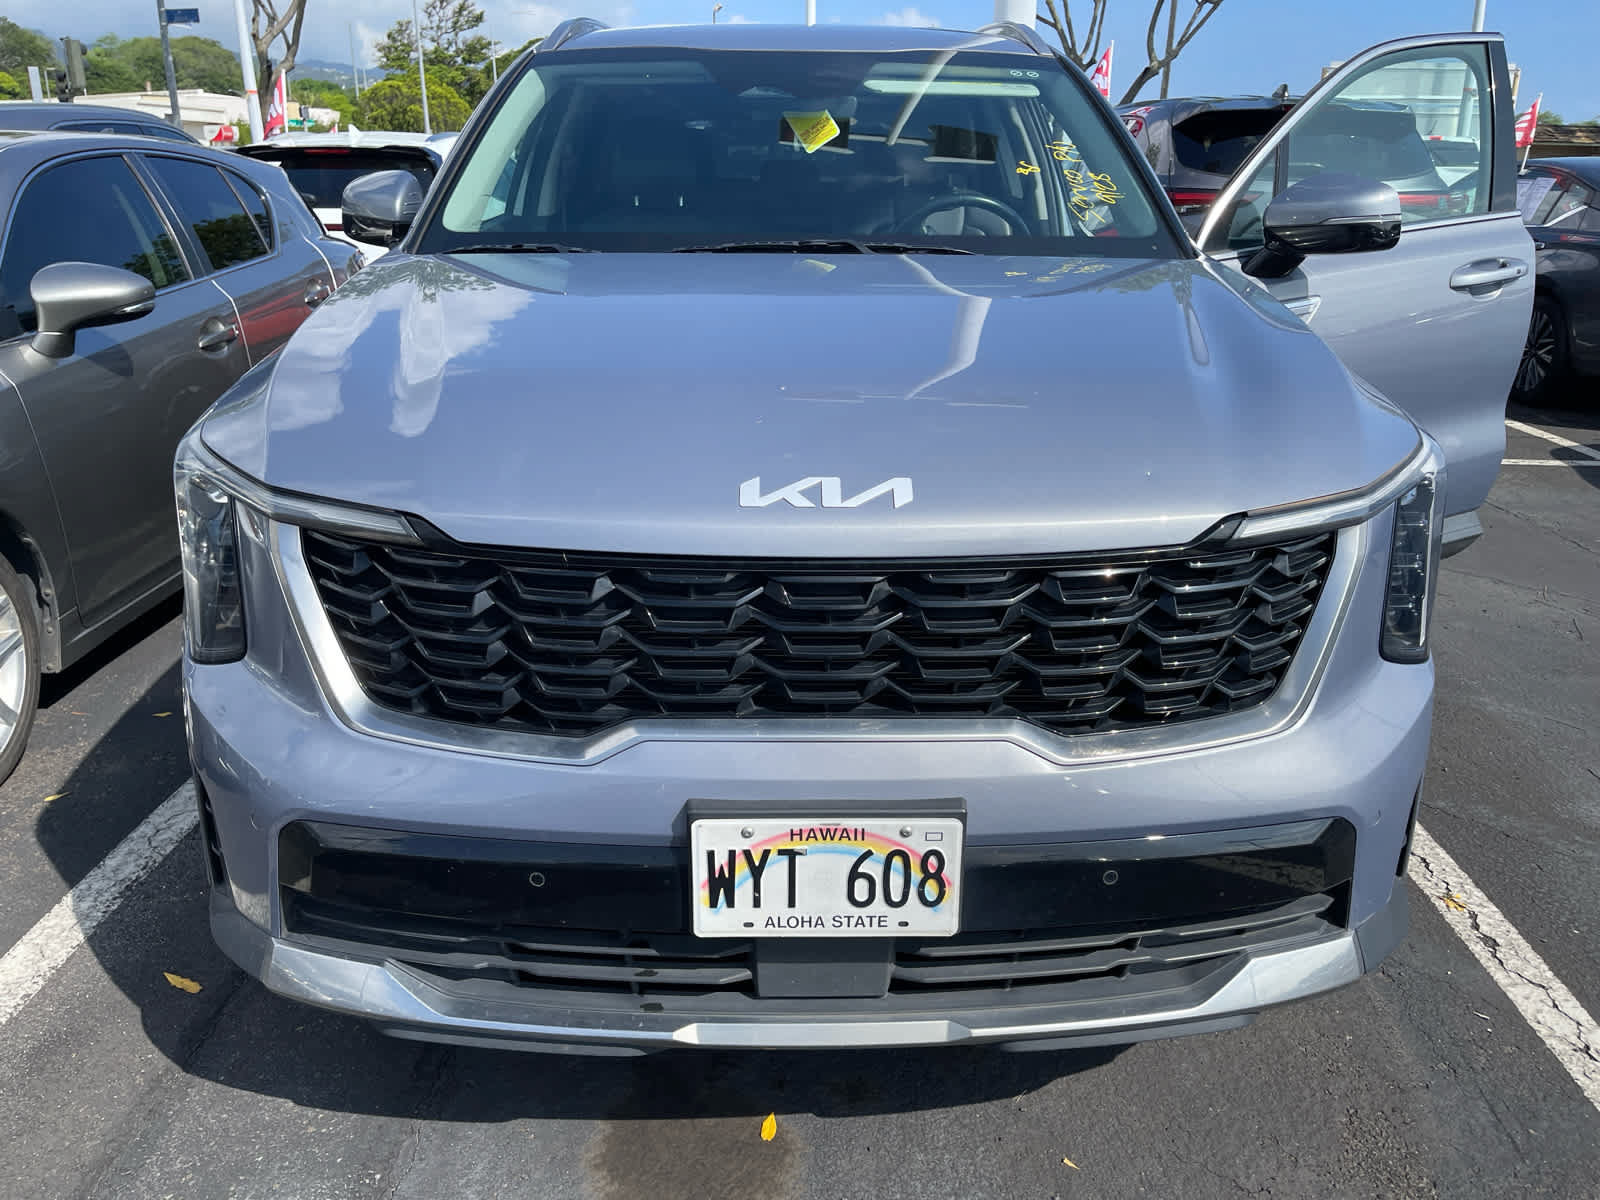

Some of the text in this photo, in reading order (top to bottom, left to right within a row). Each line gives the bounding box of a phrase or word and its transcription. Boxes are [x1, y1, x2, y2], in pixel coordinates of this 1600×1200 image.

[790, 828, 866, 841] HAWAII
[706, 848, 947, 909] WYT 608
[764, 915, 889, 929] ALOHA STATE
